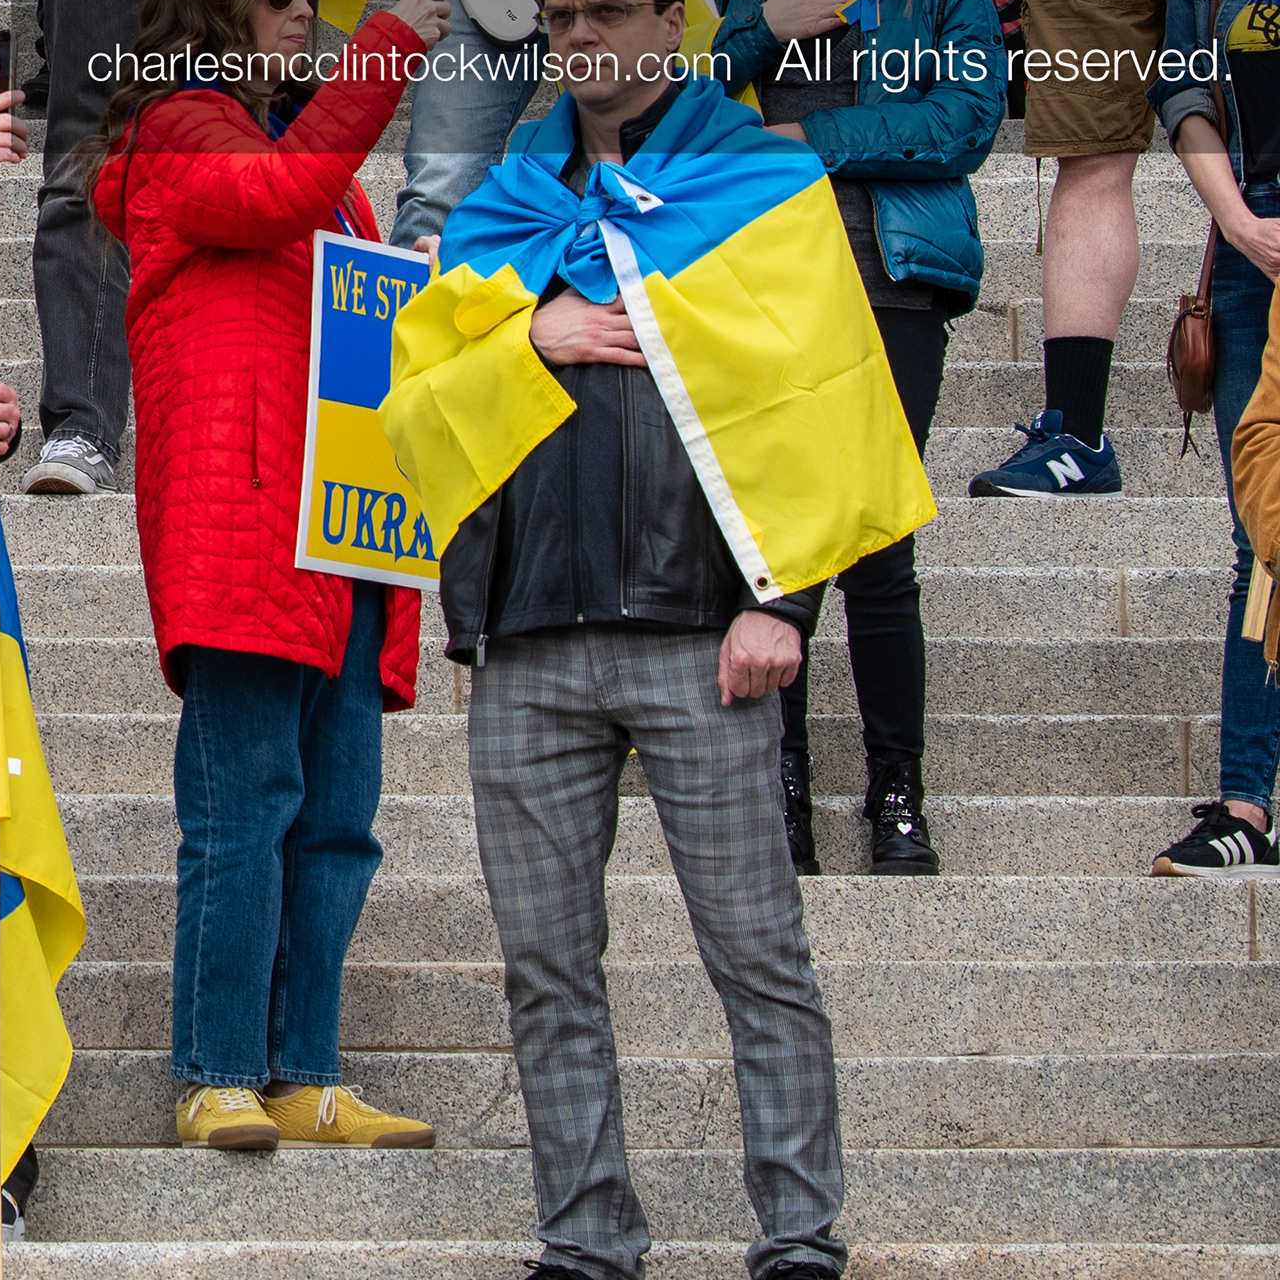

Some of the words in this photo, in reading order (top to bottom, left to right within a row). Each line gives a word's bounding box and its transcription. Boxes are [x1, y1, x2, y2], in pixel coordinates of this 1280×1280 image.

[330, 257, 367, 316] WE
[1046, 452, 1085, 488] N
[322, 480, 439, 563] UKRA
